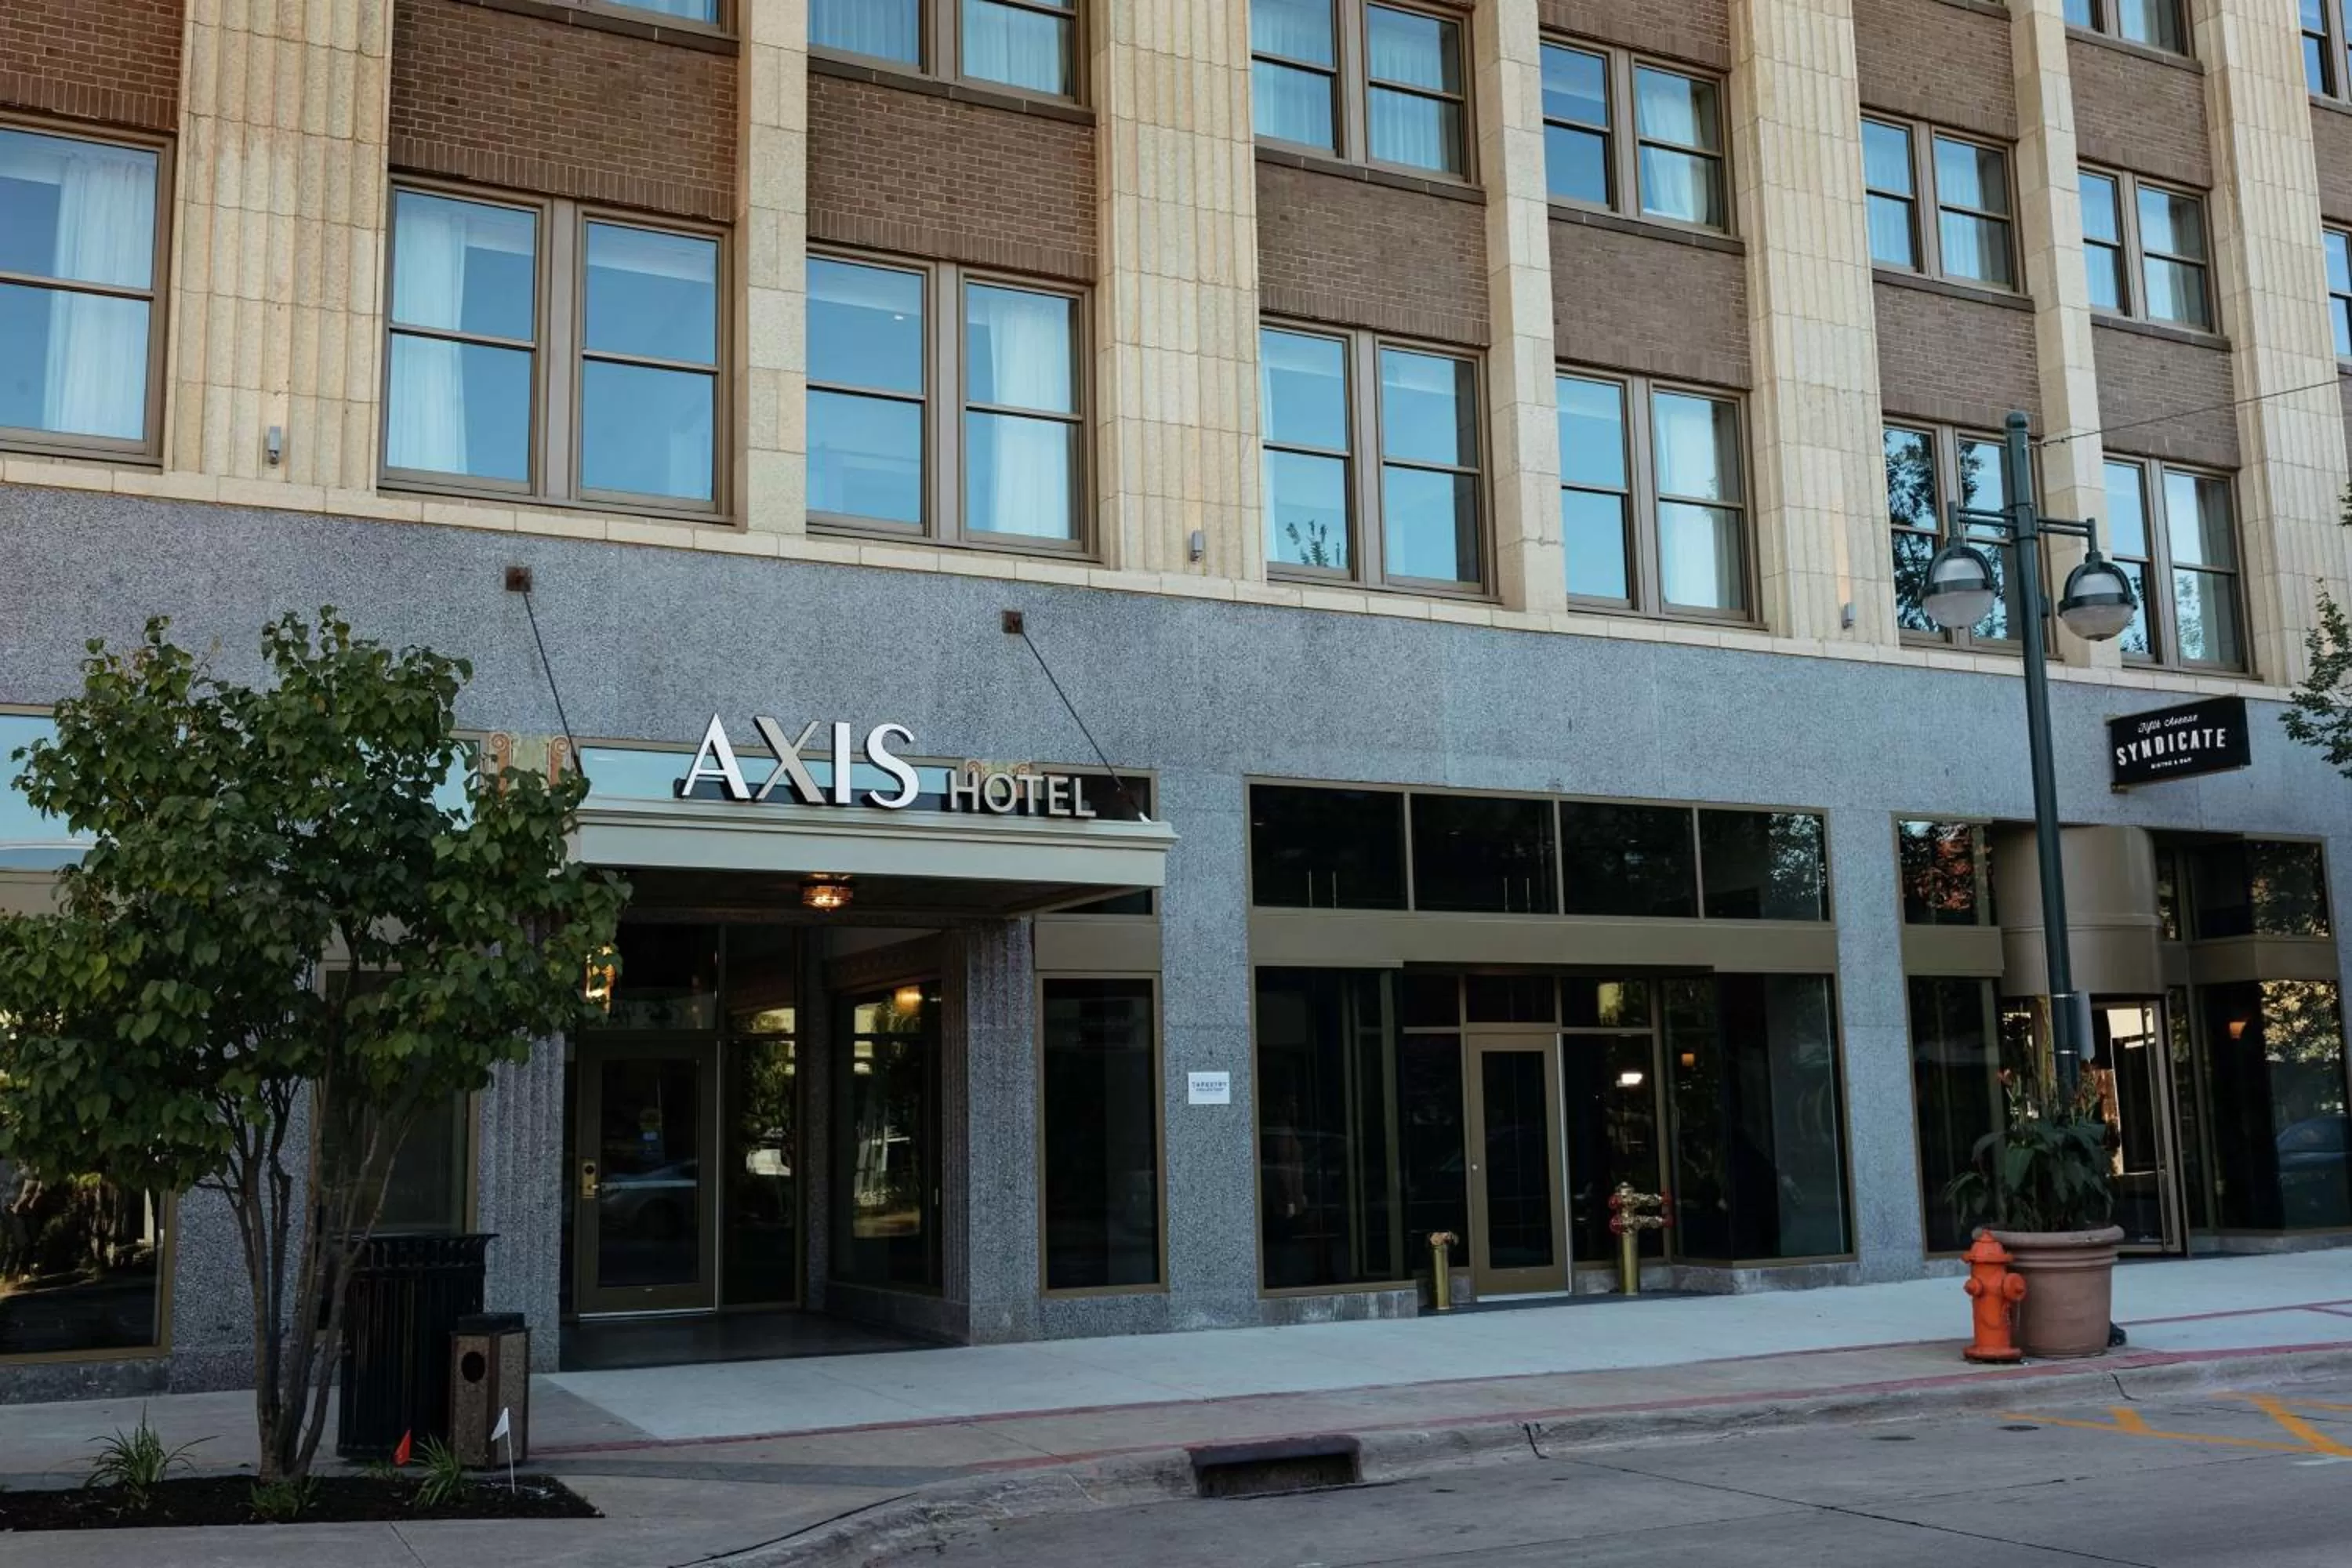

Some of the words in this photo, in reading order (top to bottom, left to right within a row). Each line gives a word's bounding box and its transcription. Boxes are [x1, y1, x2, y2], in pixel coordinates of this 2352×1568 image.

[2137, 718, 2161, 735] Fifth
[2164, 713, 2198, 728] Avenue
[681, 712, 920, 809] AXIS
[949, 769, 1097, 818] HOTEL
[2116, 728, 2227, 767] SYNDICATE
